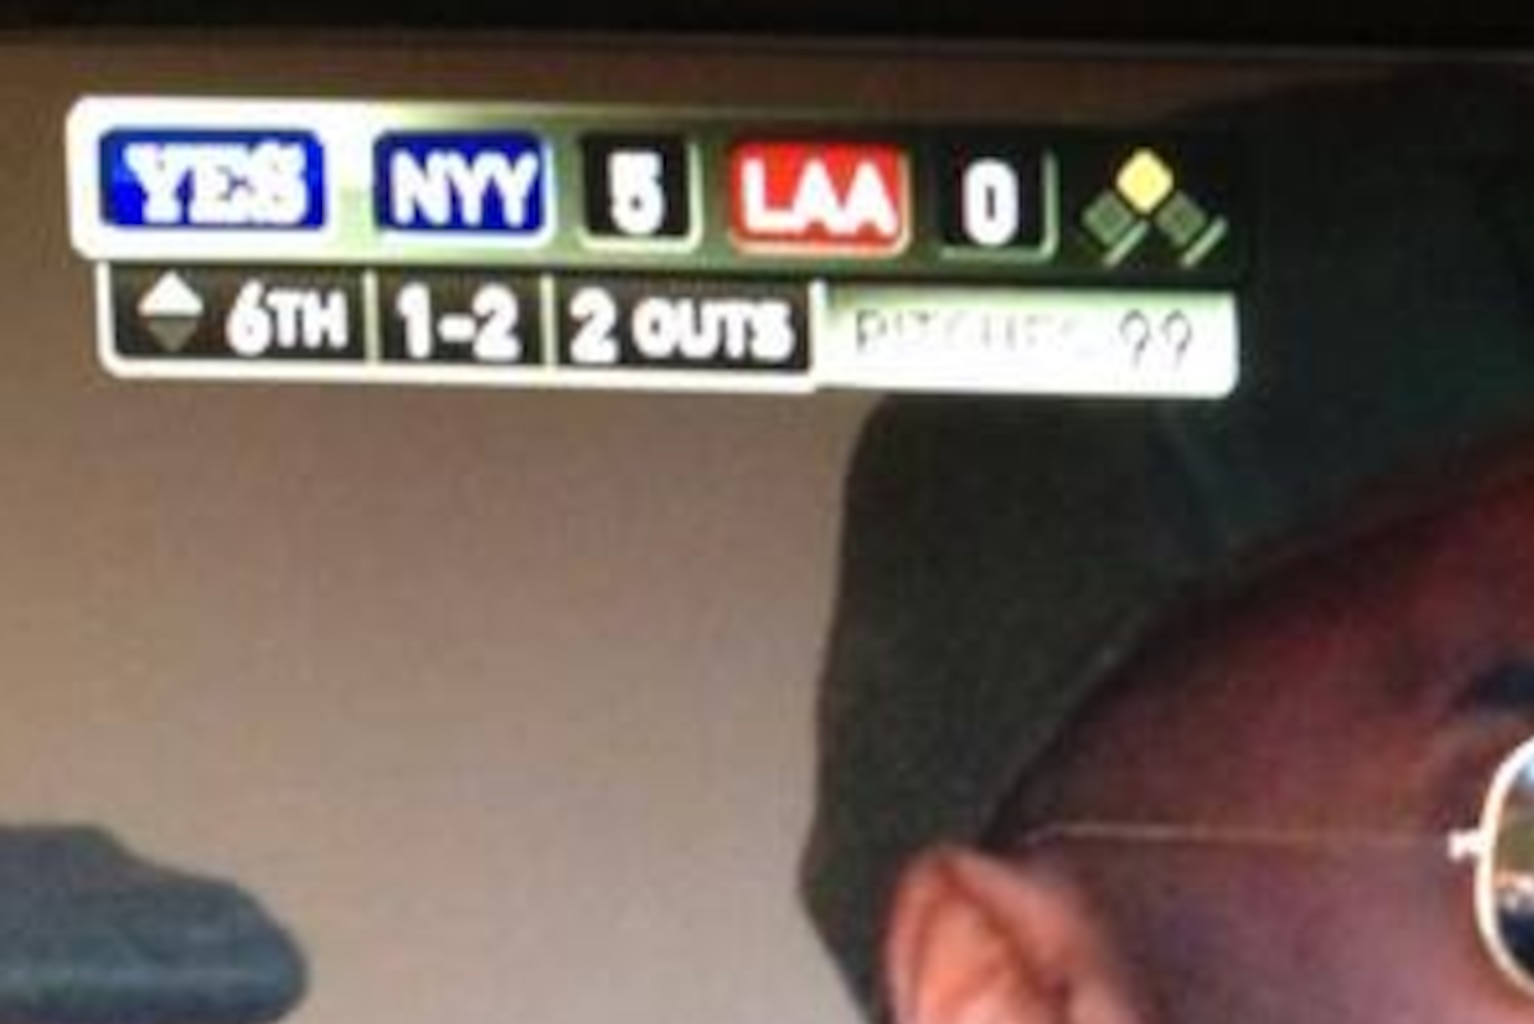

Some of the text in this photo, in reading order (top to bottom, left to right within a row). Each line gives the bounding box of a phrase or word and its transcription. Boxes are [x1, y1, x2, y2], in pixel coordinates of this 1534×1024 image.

[124, 141, 307, 225] YES
[389, 150, 665, 234] NYY 5
[740, 158, 1018, 246] LAA 0
[225, 279, 349, 355] 6TH
[396, 283, 520, 361] 1-2
[569, 286, 794, 364] 2 OUTS
[1118, 308, 1195, 370] 99
